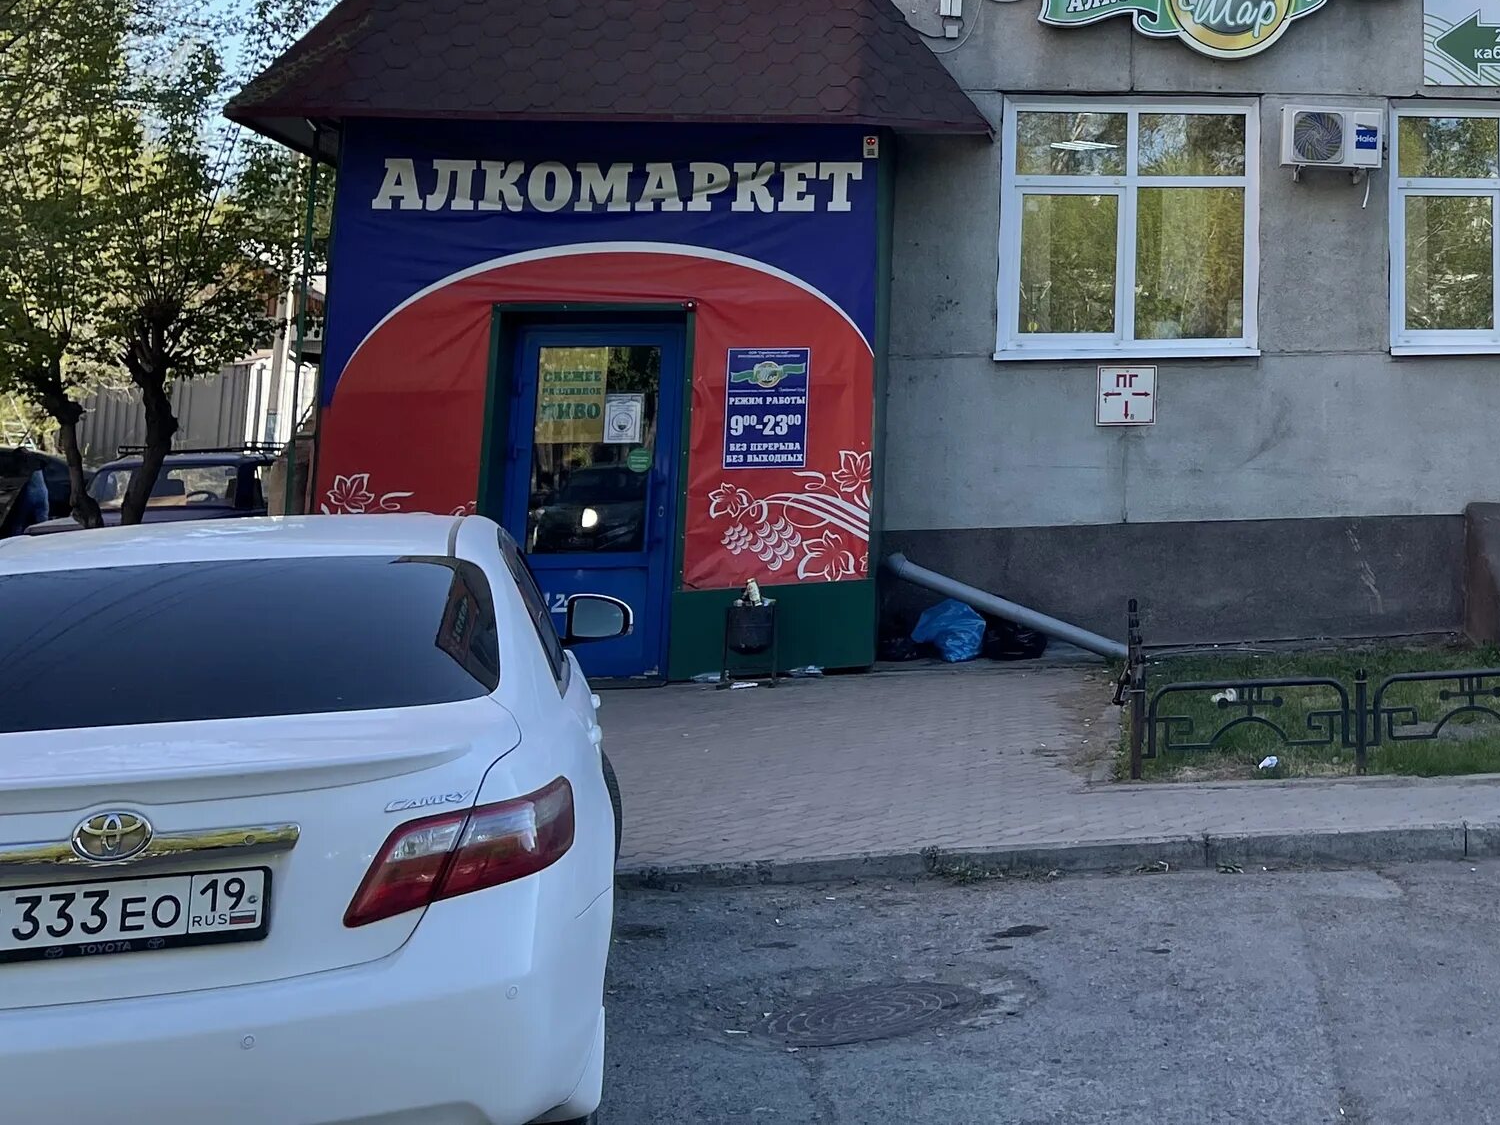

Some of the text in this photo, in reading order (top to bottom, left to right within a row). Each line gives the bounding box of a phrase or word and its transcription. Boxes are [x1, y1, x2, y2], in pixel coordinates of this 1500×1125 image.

[1356, 134, 1378, 143] Haier
[371, 157, 864, 213] АЛКОМАРКЕТ
[1116, 374, 1138, 388] ПГ
[729, 396, 806, 405] РЕЖИМ РАБОТЫ
[729, 442, 801, 452] БЕЗ ПЕРЕРЫВА
[726, 454, 803, 463] БЕЗ ВЫХОДНЫХ
[384, 789, 474, 813] CAMRY
[199, 877, 246, 913] 19
[191, 913, 228, 928] RUS
[78, 941, 132, 956] TOYOTA
